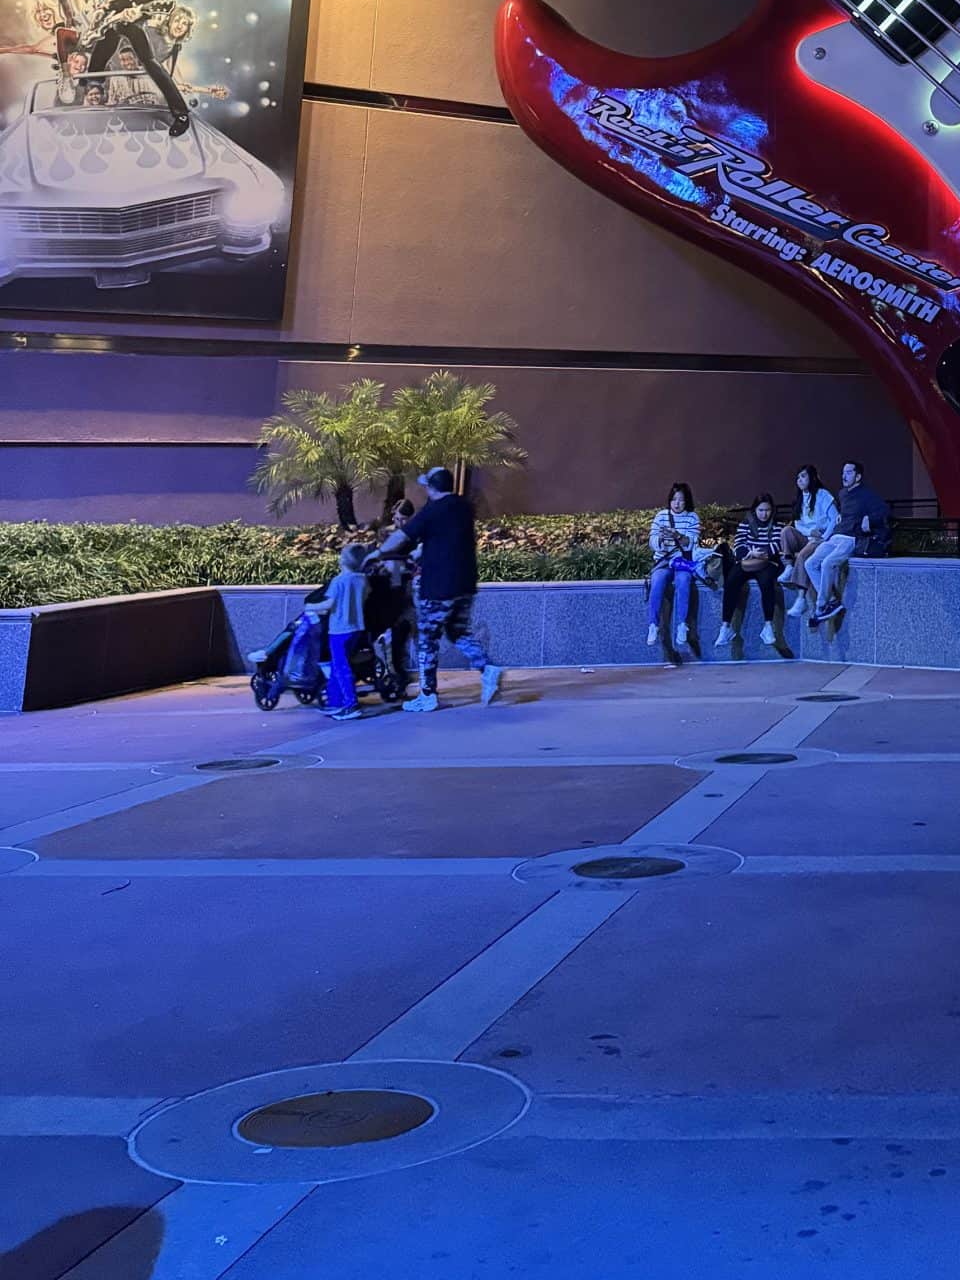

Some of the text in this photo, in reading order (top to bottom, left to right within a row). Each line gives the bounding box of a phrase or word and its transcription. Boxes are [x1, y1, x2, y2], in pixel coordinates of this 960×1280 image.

[677, 127, 849, 232] Roller
[710, 204, 941, 323] Starring: AEROSMITH
